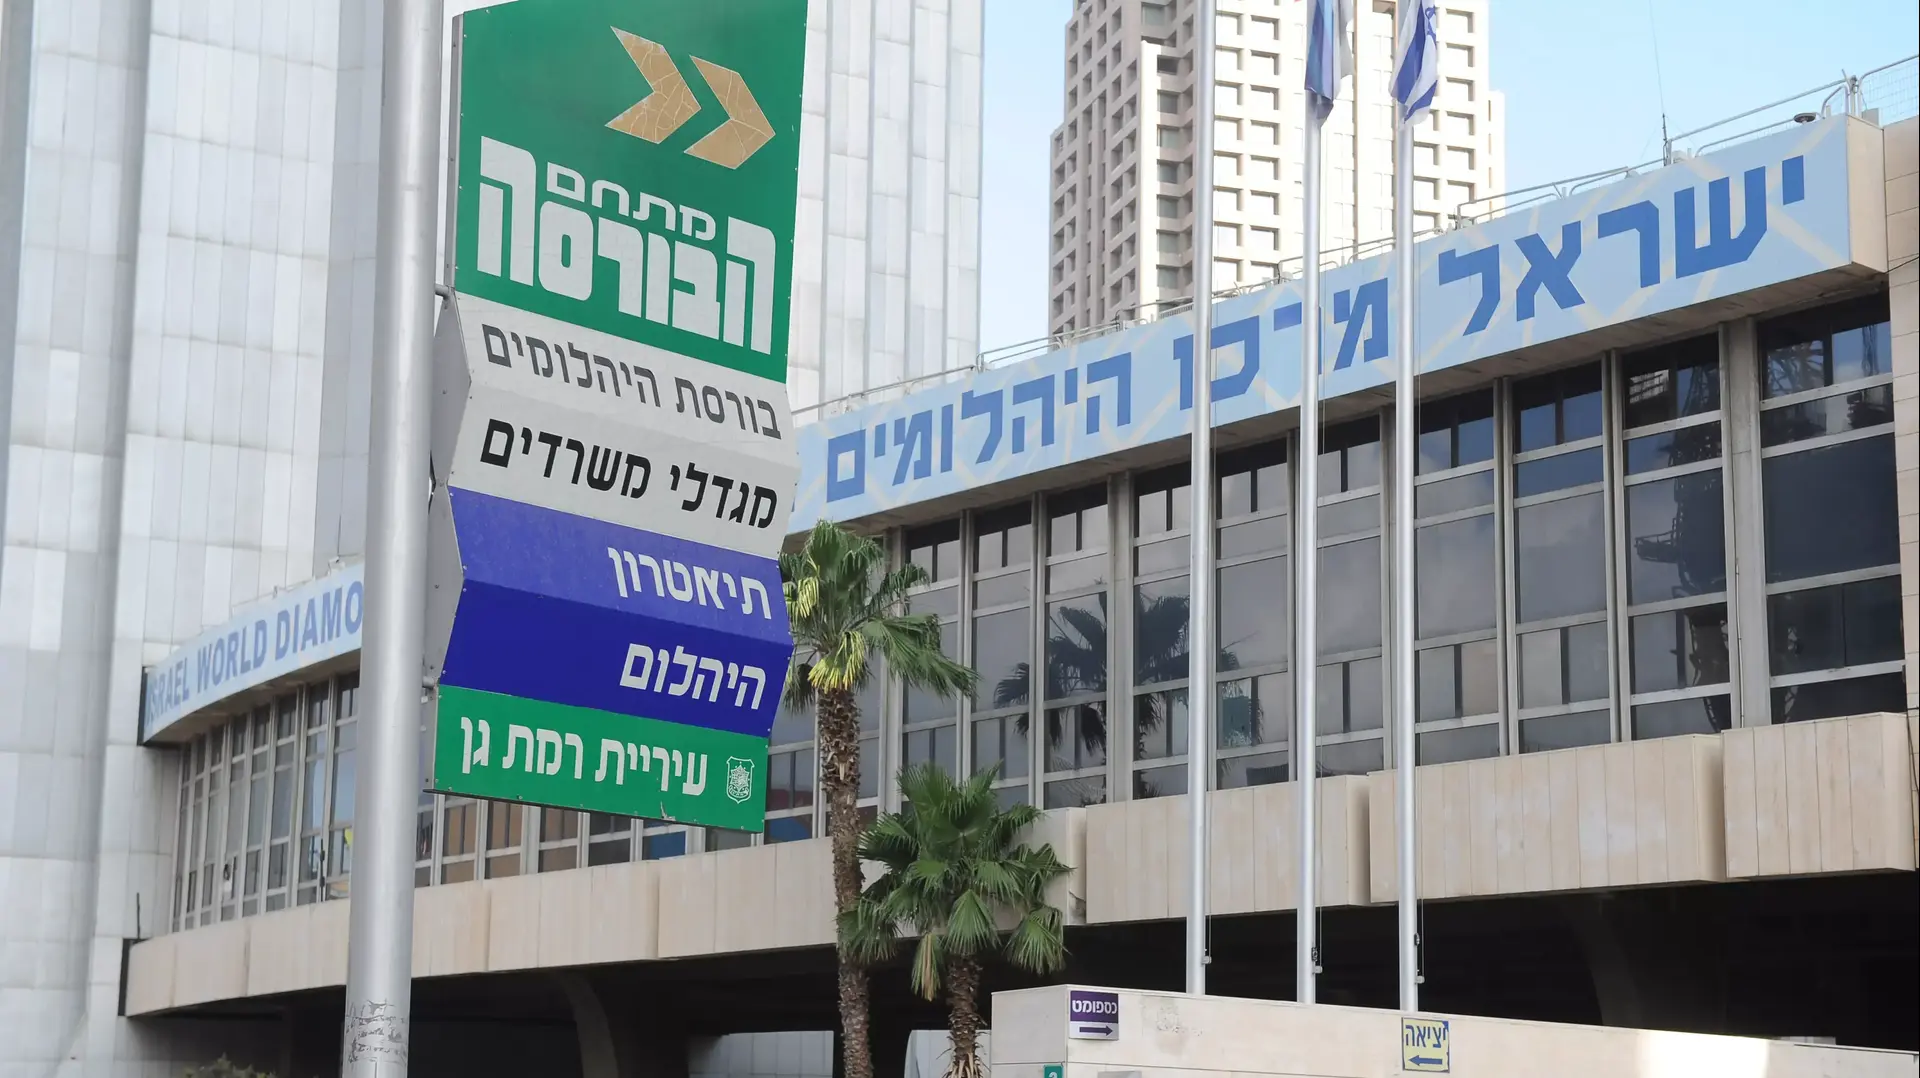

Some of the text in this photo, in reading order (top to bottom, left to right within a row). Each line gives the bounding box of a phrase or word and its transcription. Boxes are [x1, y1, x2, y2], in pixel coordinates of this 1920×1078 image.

[476, 135, 777, 356] הבורסה
[546, 161, 717, 241] מתחם
[1438, 154, 1806, 337] ישראל
[481, 323, 782, 440] בורסת היהלומים
[825, 351, 1132, 503] היהלומים
[479, 417, 778, 529] מגדלי משרדים
[606, 546, 772, 620] תיאטרון
[197, 619, 268, 694] WORLD
[275, 580, 364, 661] DIAMO
[619, 642, 767, 711] היהלום
[460, 715, 708, 796] עיריית רמת גן
[1071, 1000, 1118, 1014] כספומט
[1405, 1024, 1446, 1048] יציאה
